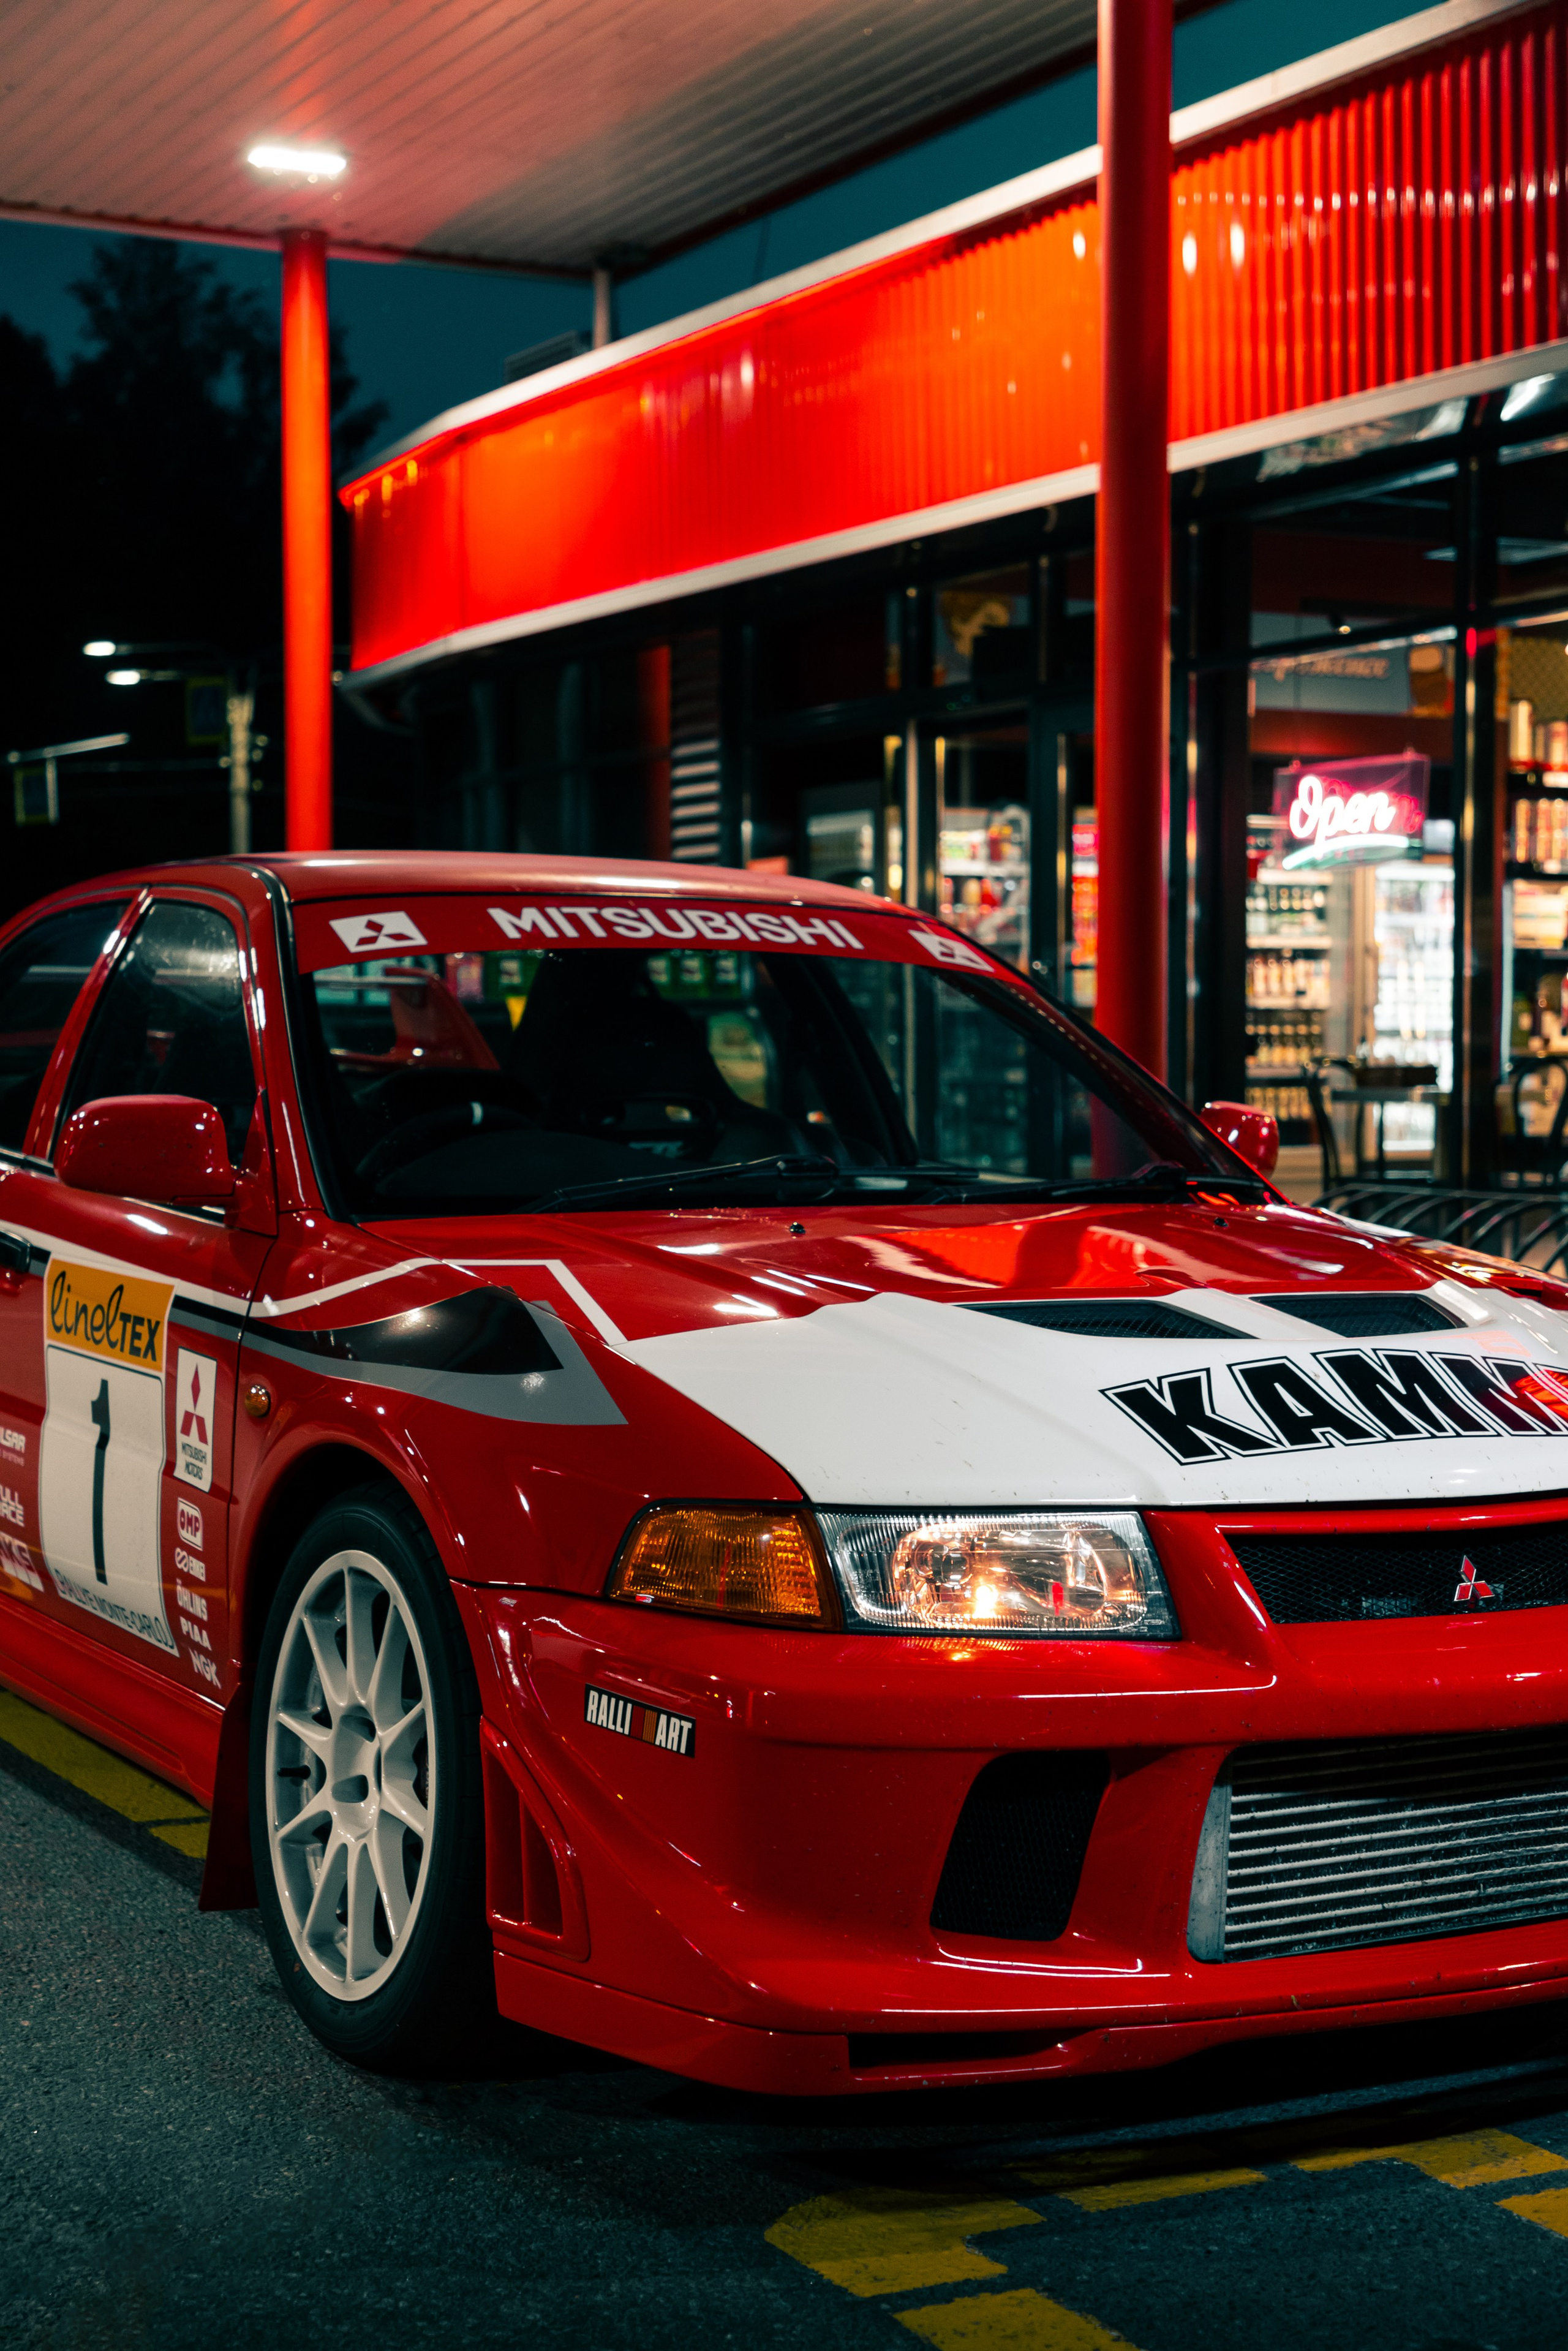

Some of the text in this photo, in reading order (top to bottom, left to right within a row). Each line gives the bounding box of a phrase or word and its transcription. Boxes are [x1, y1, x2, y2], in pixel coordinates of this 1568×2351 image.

[1289, 775, 1397, 860] Open
[488, 905, 864, 951] MITSUBISHI
[51, 1270, 160, 1362] linelTEX
[1098, 1348, 1568, 1466] KAMM
[91, 1378, 110, 1585] 1
[179, 1616, 213, 1651] PIAA
[188, 1645, 222, 1689] NGK
[586, 1690, 693, 1754] RALLI ART
